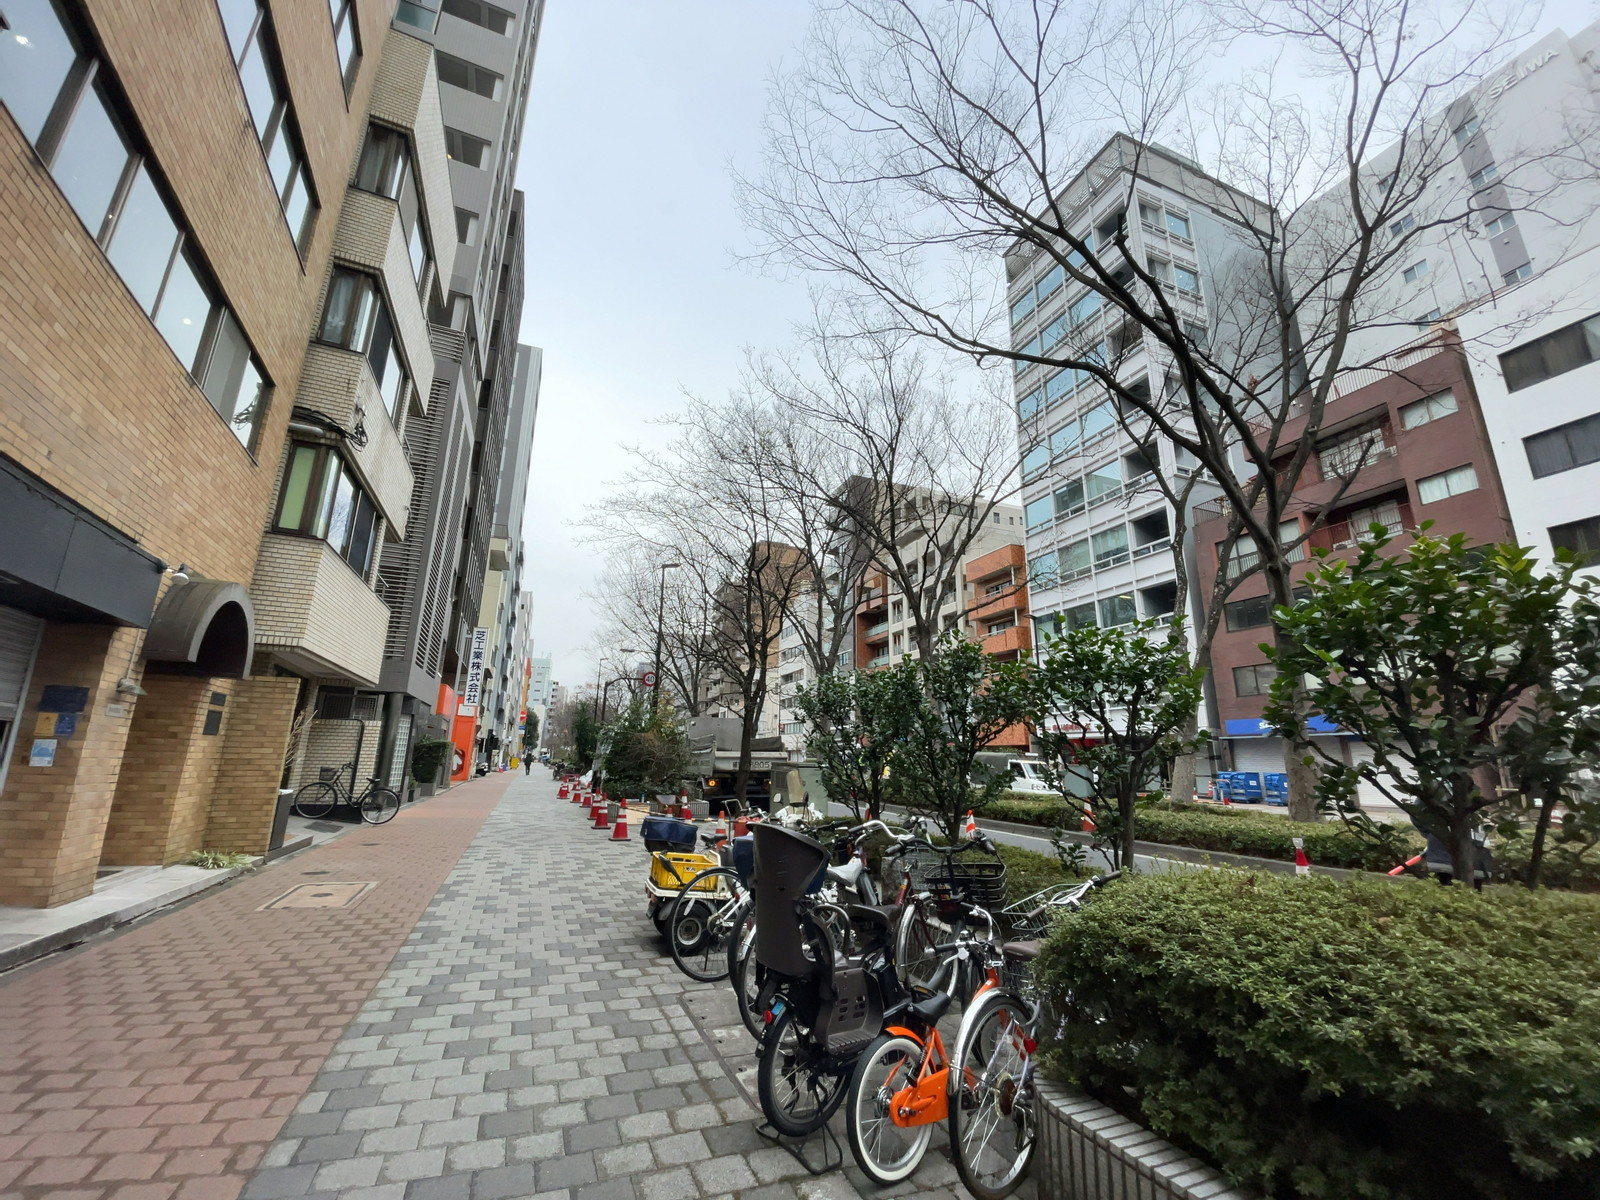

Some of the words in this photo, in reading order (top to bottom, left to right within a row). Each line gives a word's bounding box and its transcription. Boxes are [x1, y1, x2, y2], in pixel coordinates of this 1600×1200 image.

[1489, 49, 1560, 99] SEIWA
[466, 630, 486, 704] 芝工業株式会社
